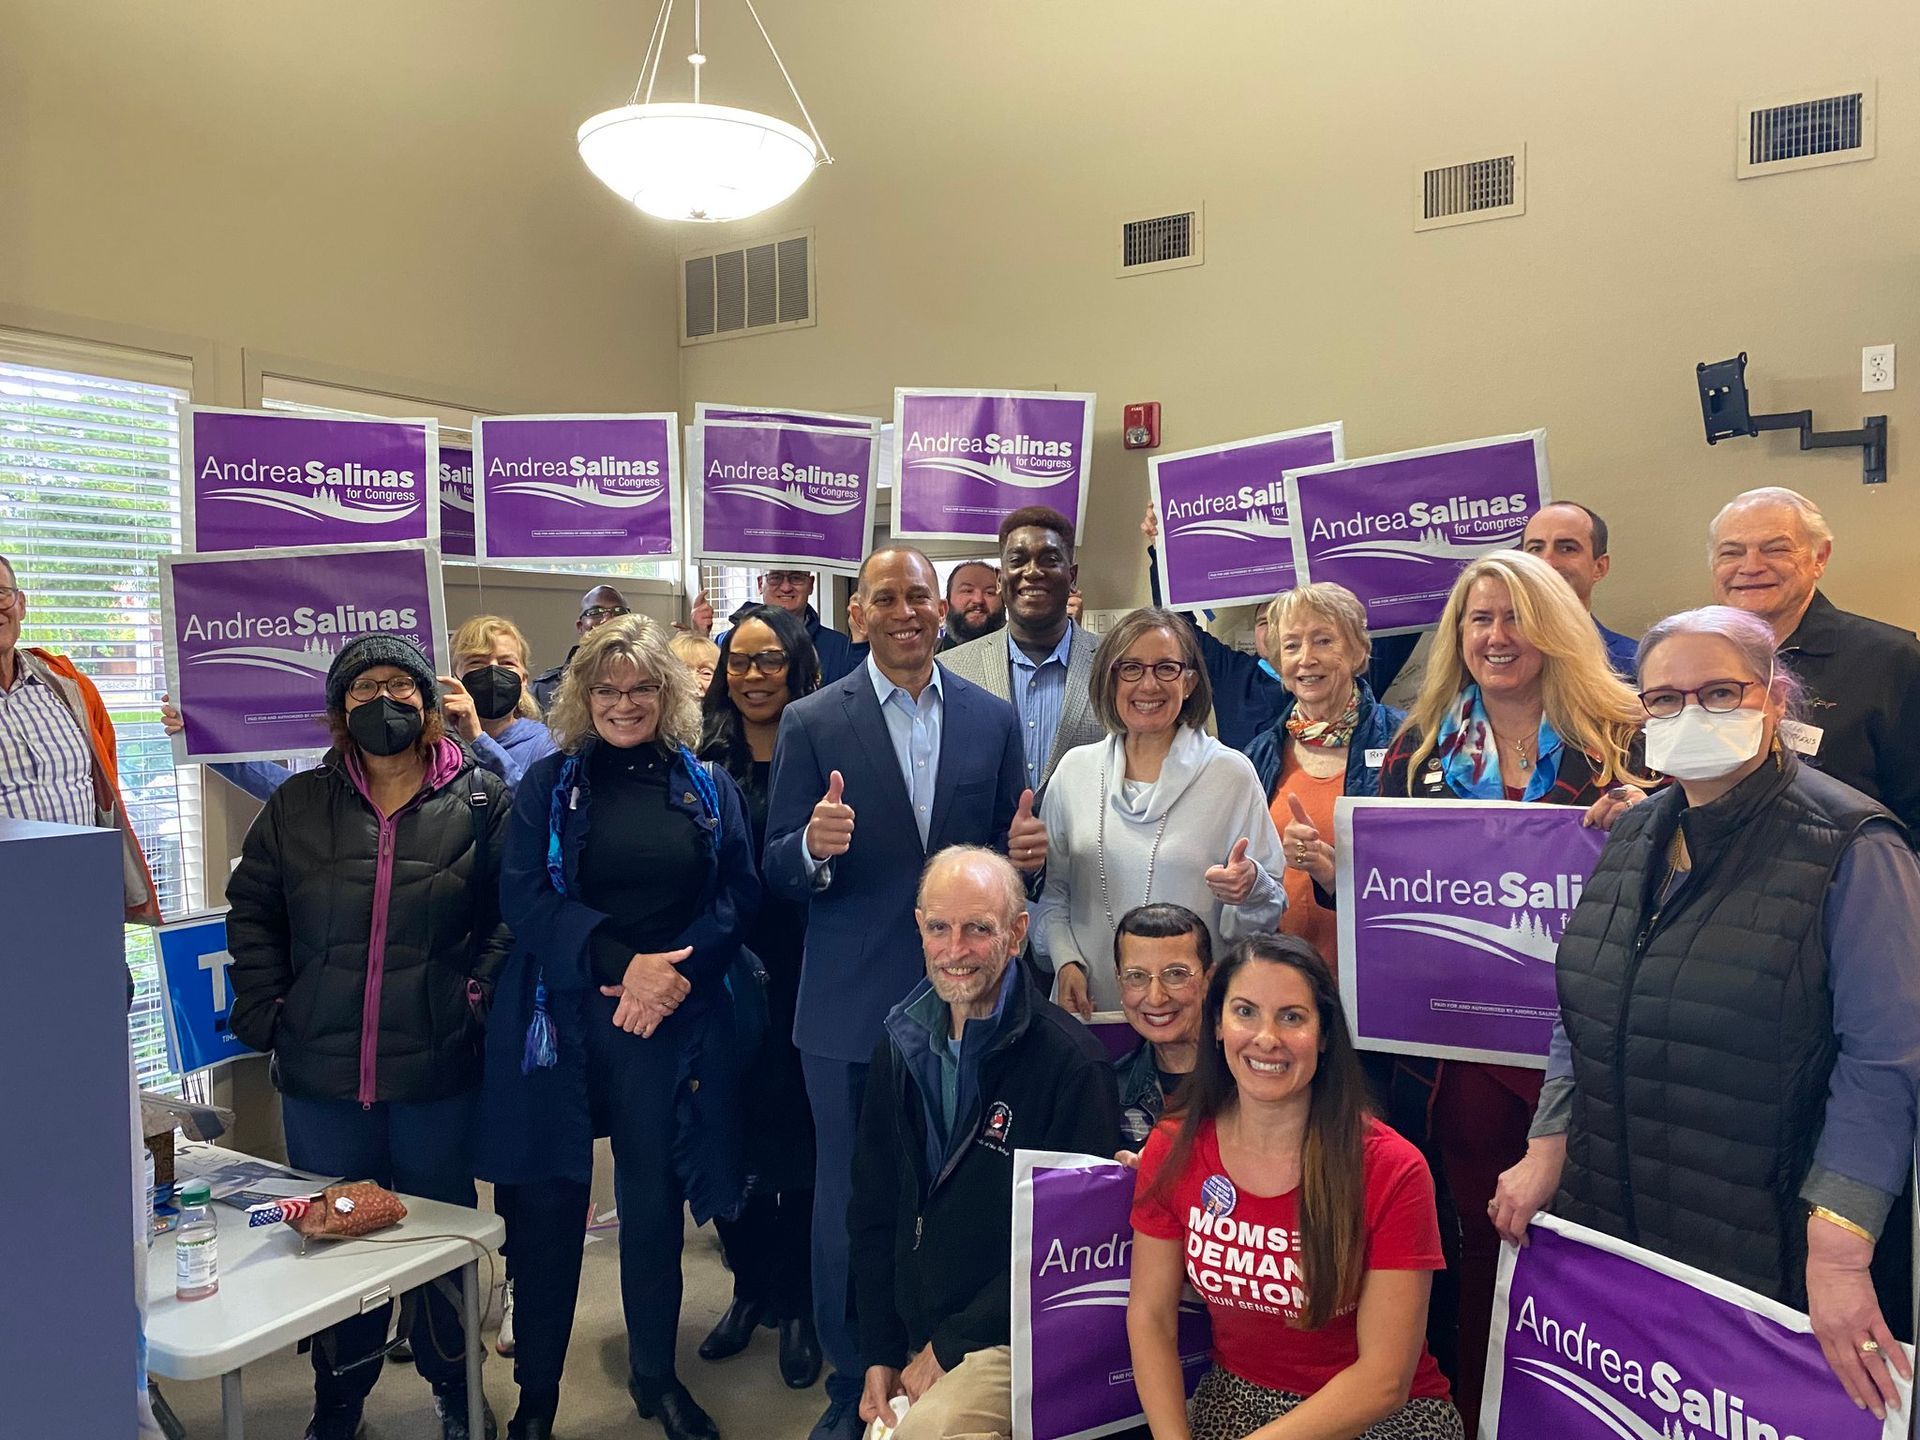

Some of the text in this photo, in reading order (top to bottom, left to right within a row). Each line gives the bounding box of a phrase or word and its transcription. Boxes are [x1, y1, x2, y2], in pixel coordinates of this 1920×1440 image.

[906, 431, 1072, 457] Andrea Salinas
[200, 456, 414, 488] Andrea Salinas
[440, 463, 472, 484] Sali
[489, 456, 659, 477] Andrea Salinas
[708, 459, 860, 488] Andrea Salinas
[1016, 456, 1072, 469] for Congress
[346, 488, 415, 502] for Congress
[603, 477, 660, 488] for Congress
[808, 484, 859, 498] for Congress
[1166, 481, 1283, 520] Andrea Sali
[1272, 505, 1284, 516] for
[1310, 493, 1528, 542] Andrea Salinas
[1454, 516, 1528, 535] for Congress
[183, 604, 418, 642] Andrea Salinas
[341, 634, 353, 646] fo
[1362, 868, 1582, 910] Andrea Sali
[1188, 1206, 1288, 1252] MOMS
[1038, 1234, 1132, 1277] Andr
[1187, 1231, 1304, 1282] DEMAN
[1187, 1260, 1310, 1308] ACTION
[1208, 1294, 1298, 1318] GUN SENSE IN
[1515, 1296, 1806, 1440] Andrea Salin
